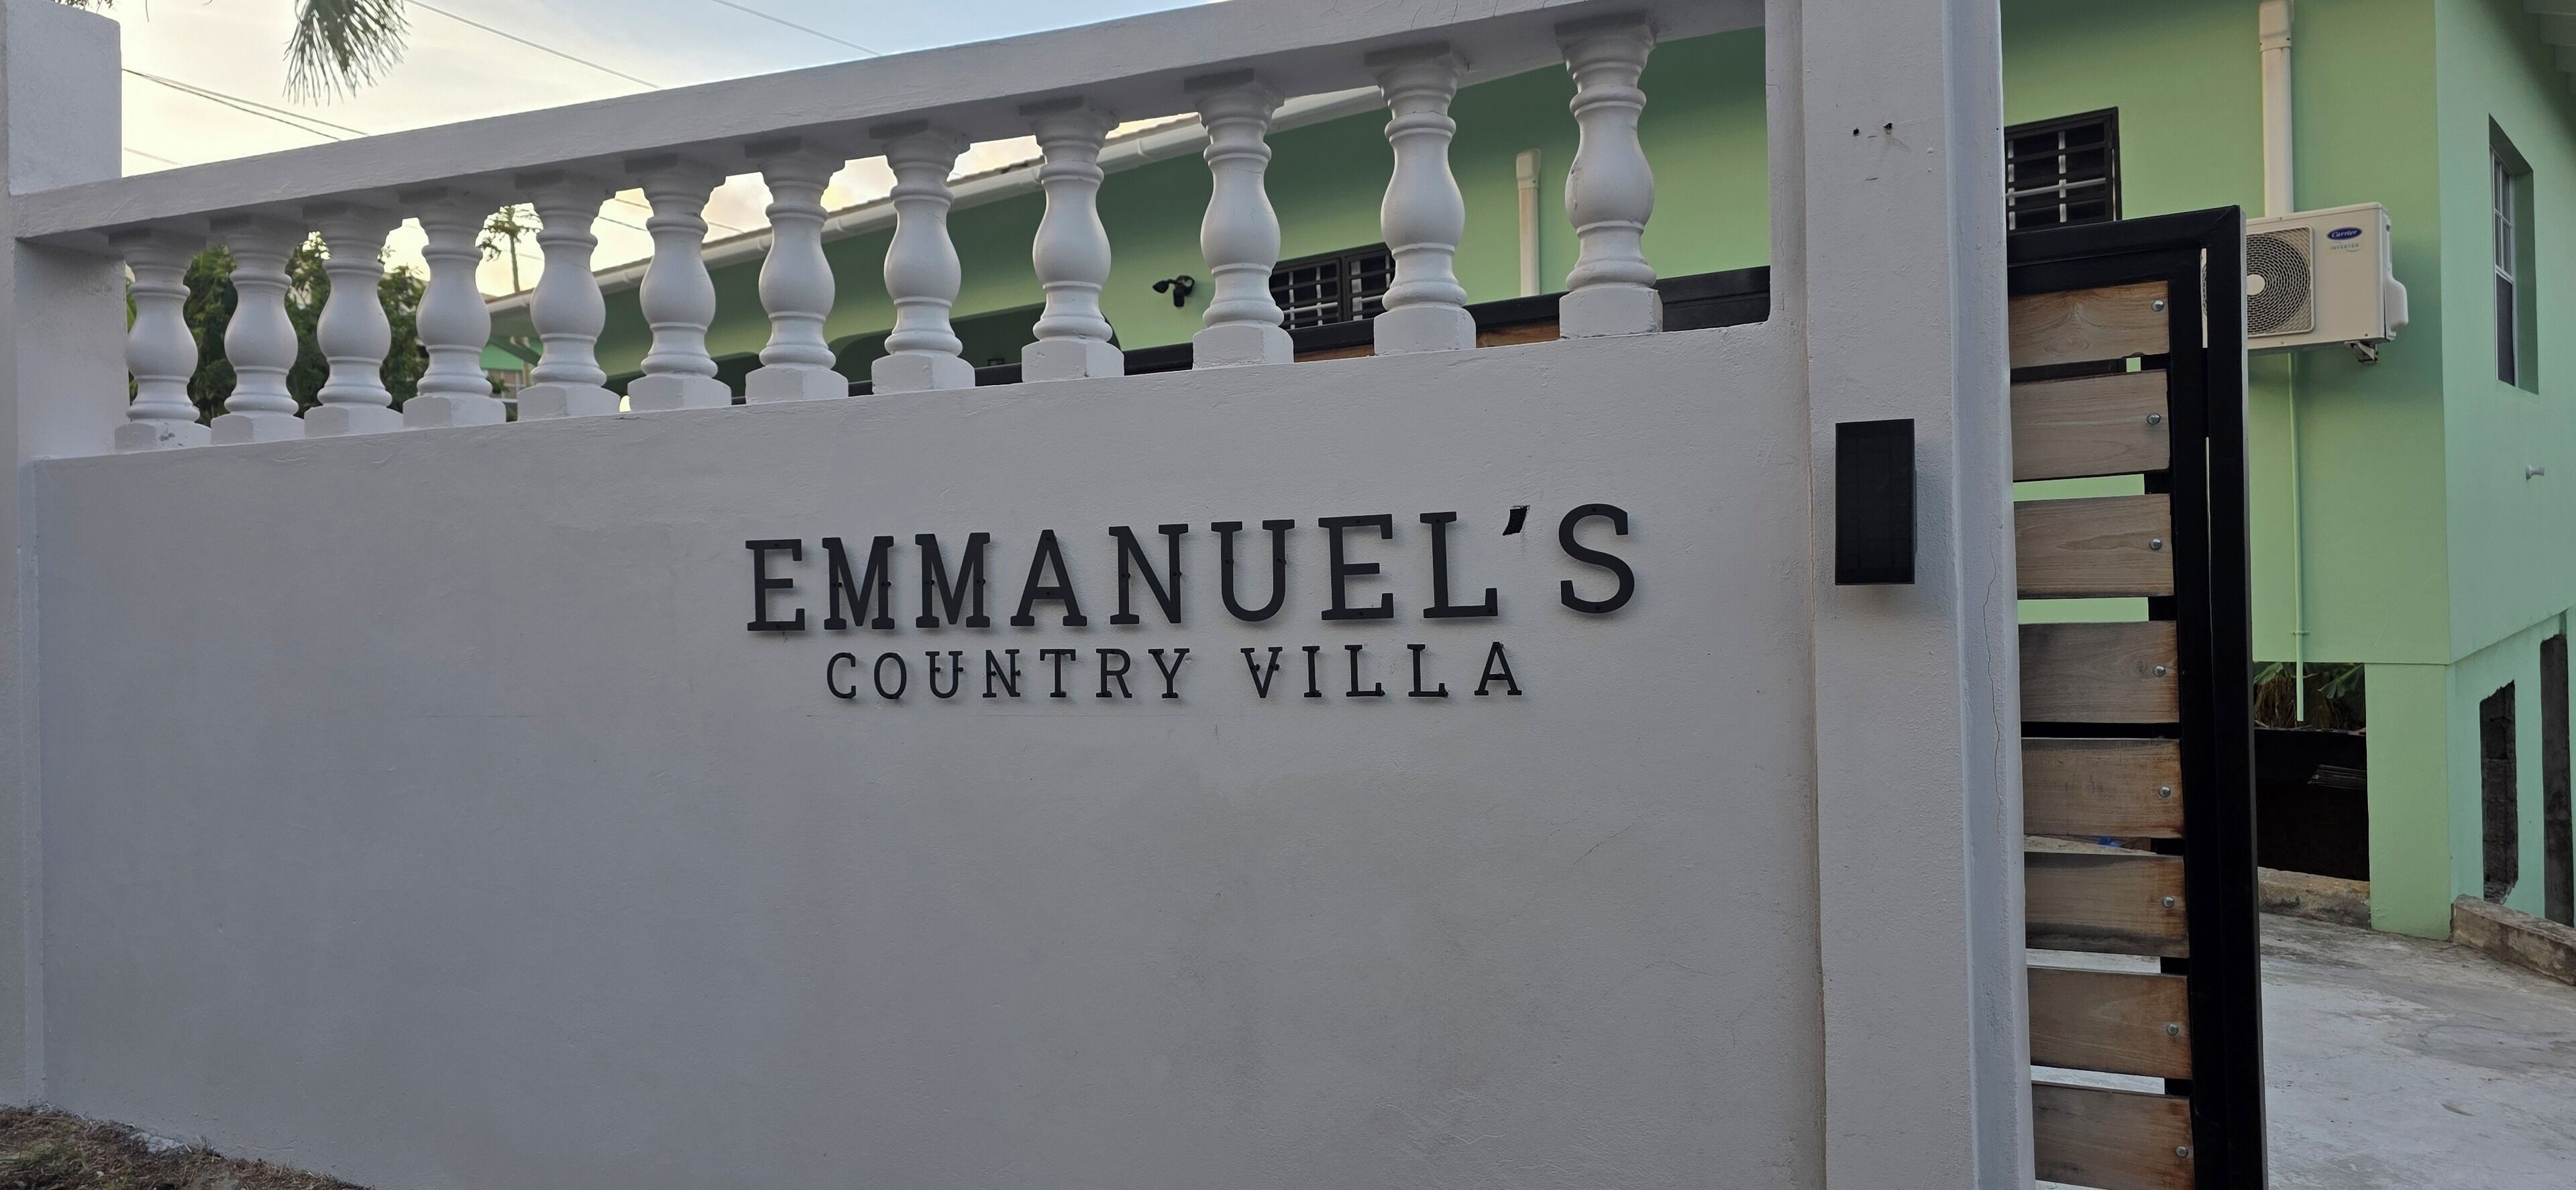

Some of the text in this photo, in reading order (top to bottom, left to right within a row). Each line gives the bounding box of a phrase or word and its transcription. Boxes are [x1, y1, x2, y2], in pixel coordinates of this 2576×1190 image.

[2331, 230, 2358, 238] Carrier
[745, 503, 1635, 631] EMMANUEL'S
[826, 641, 1523, 702] COUNTRY VILLA
